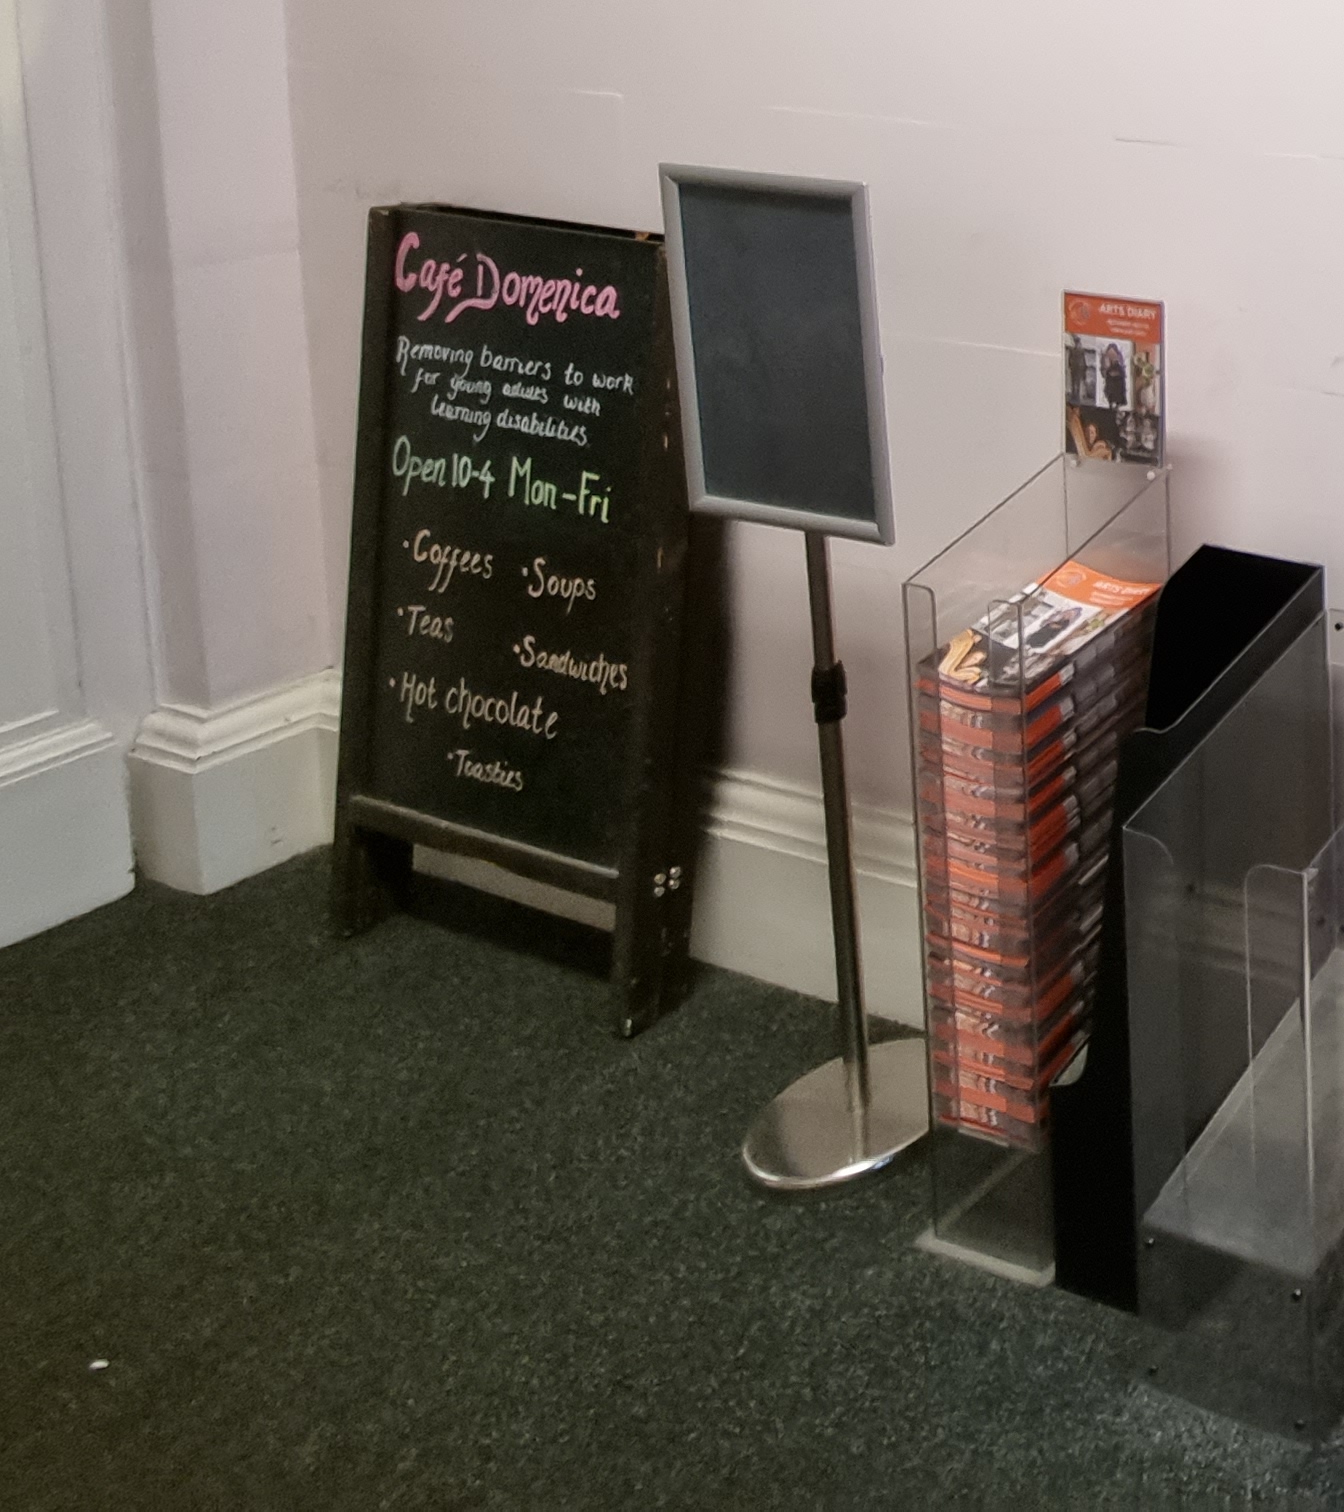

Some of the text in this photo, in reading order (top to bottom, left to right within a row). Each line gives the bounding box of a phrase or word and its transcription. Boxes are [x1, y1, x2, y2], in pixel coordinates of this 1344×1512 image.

[395, 231, 620, 325] Café Domenica
[396, 335, 634, 395] Removing barriers to work
[411, 368, 601, 416] for young adults with
[496, 409, 588, 446] disabilities
[392, 435, 446, 496] Open
[452, 453, 495, 499] 10-4
[413, 529, 493, 593] Coffees
[527, 557, 597, 615] Soups
[408, 605, 454, 643] Teas
[520, 635, 628, 695] Sandwiches
[400, 672, 559, 740] Hot chocolate
[456, 749, 524, 792] Toasties
